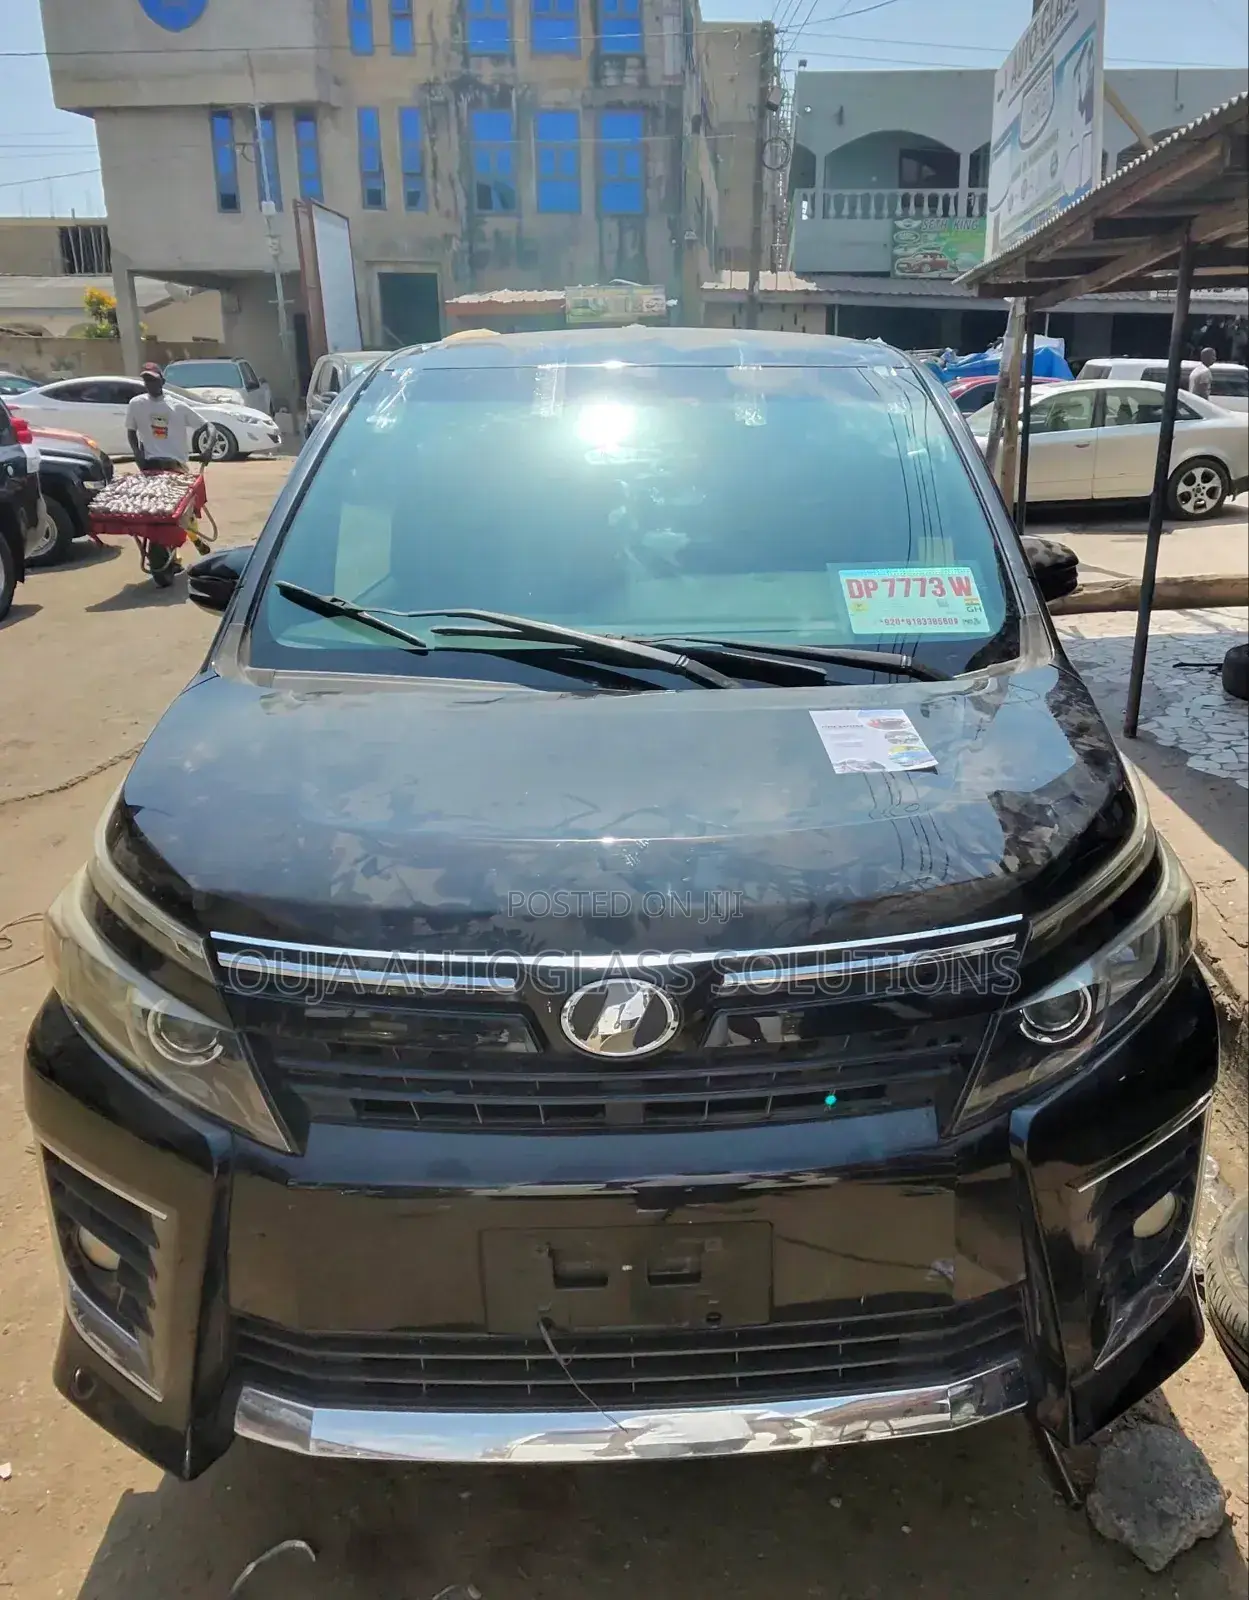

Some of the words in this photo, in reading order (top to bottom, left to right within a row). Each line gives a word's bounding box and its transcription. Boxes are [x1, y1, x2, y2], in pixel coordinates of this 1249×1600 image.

[920, 219, 948, 231] SETH
[953, 219, 978, 231] KING
[845, 578, 879, 599] DP
[881, 577, 947, 598] 7773
[947, 576, 973, 597] W
